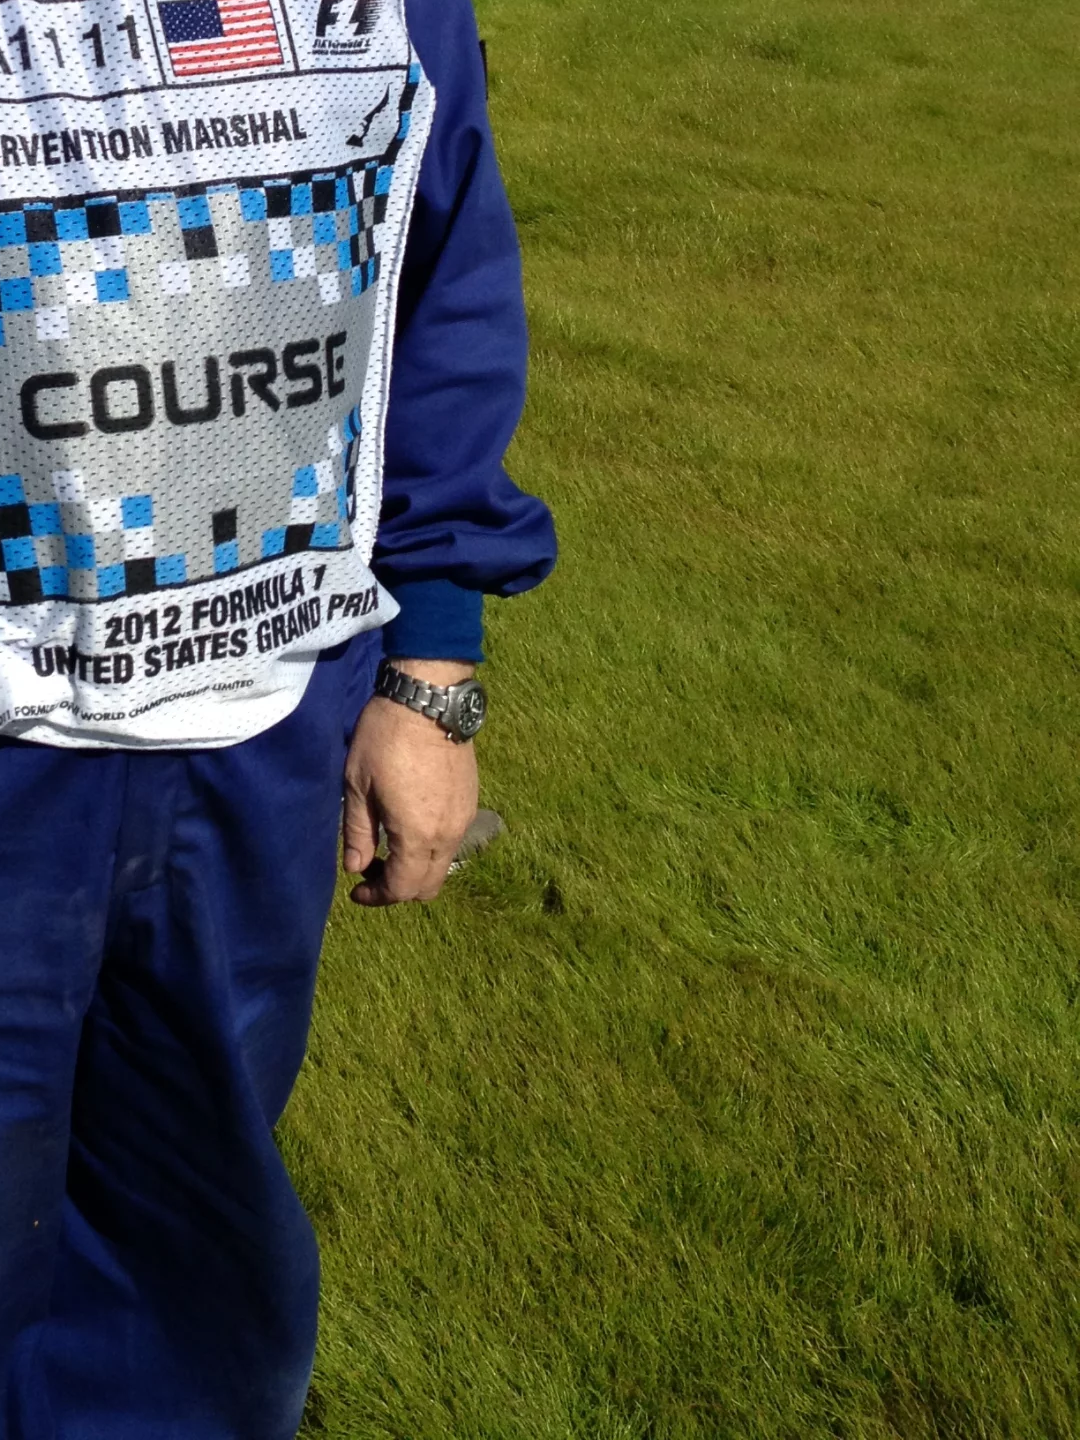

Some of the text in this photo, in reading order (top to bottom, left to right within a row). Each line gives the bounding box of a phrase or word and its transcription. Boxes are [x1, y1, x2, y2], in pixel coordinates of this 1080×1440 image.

[163, 108, 308, 151] MARSHAL
[21, 331, 347, 440] COURSE
[32, 586, 379, 685] UNTED STATES GRAND PRIX
[104, 564, 326, 650] 2012 FORMULA 1
[81, 710, 125, 722] WORLD
[128, 685, 210, 718] CHAMPIONSHIP
[211, 678, 255, 692] LIMITED
